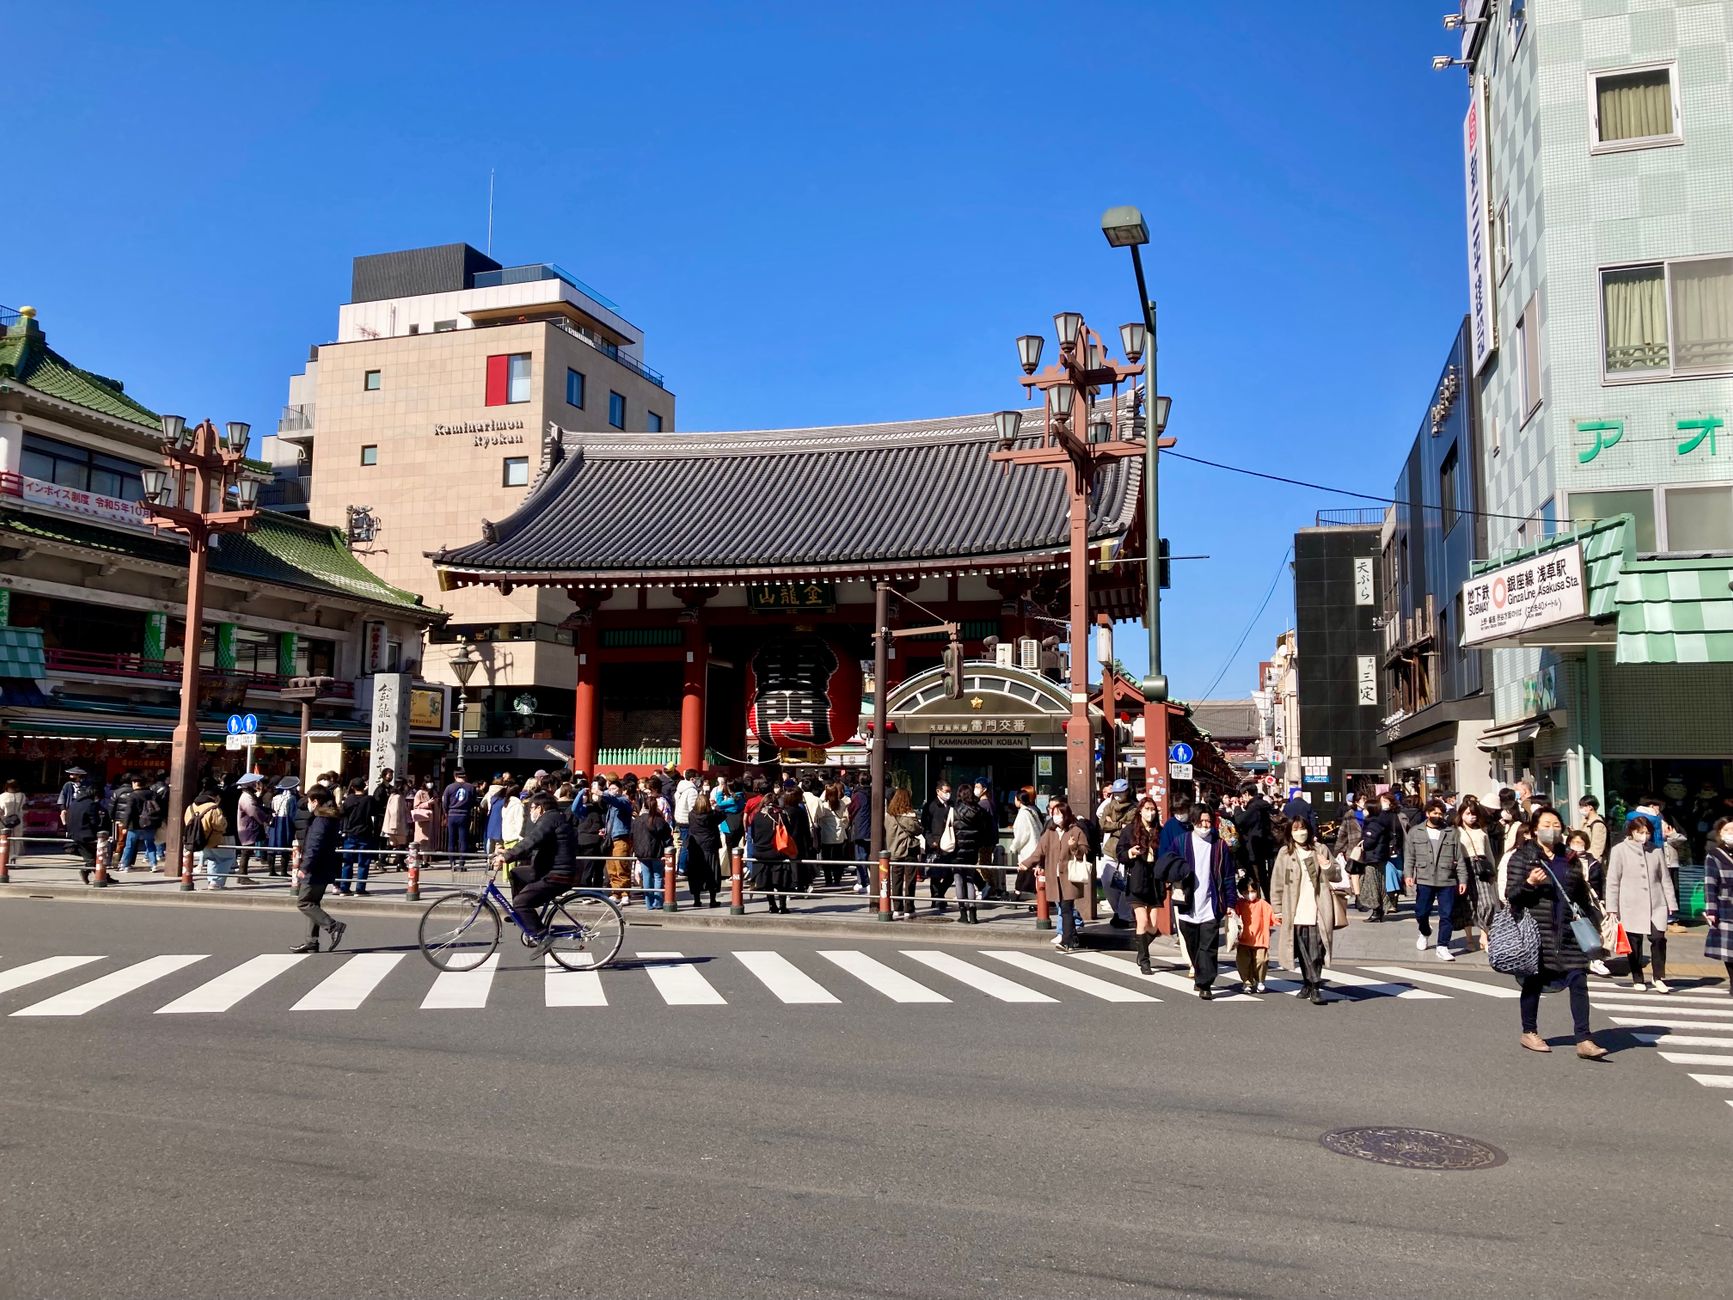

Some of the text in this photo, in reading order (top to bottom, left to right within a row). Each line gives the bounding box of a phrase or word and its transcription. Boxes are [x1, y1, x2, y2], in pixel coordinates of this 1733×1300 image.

[472, 434, 524, 449] Ryokan
[25, 481, 90, 506] インボイス制度
[1467, 558, 1567, 605] 地下鉄 銀座線 浅草駅
[1468, 575, 1579, 616] SUBWAY Ginza Line Asakusa Sta.
[1360, 672, 1375, 702] 三定
[971, 719, 1026, 732] 雷門交番
[938, 738, 1023, 746] KAMINARIMON KOBAN
